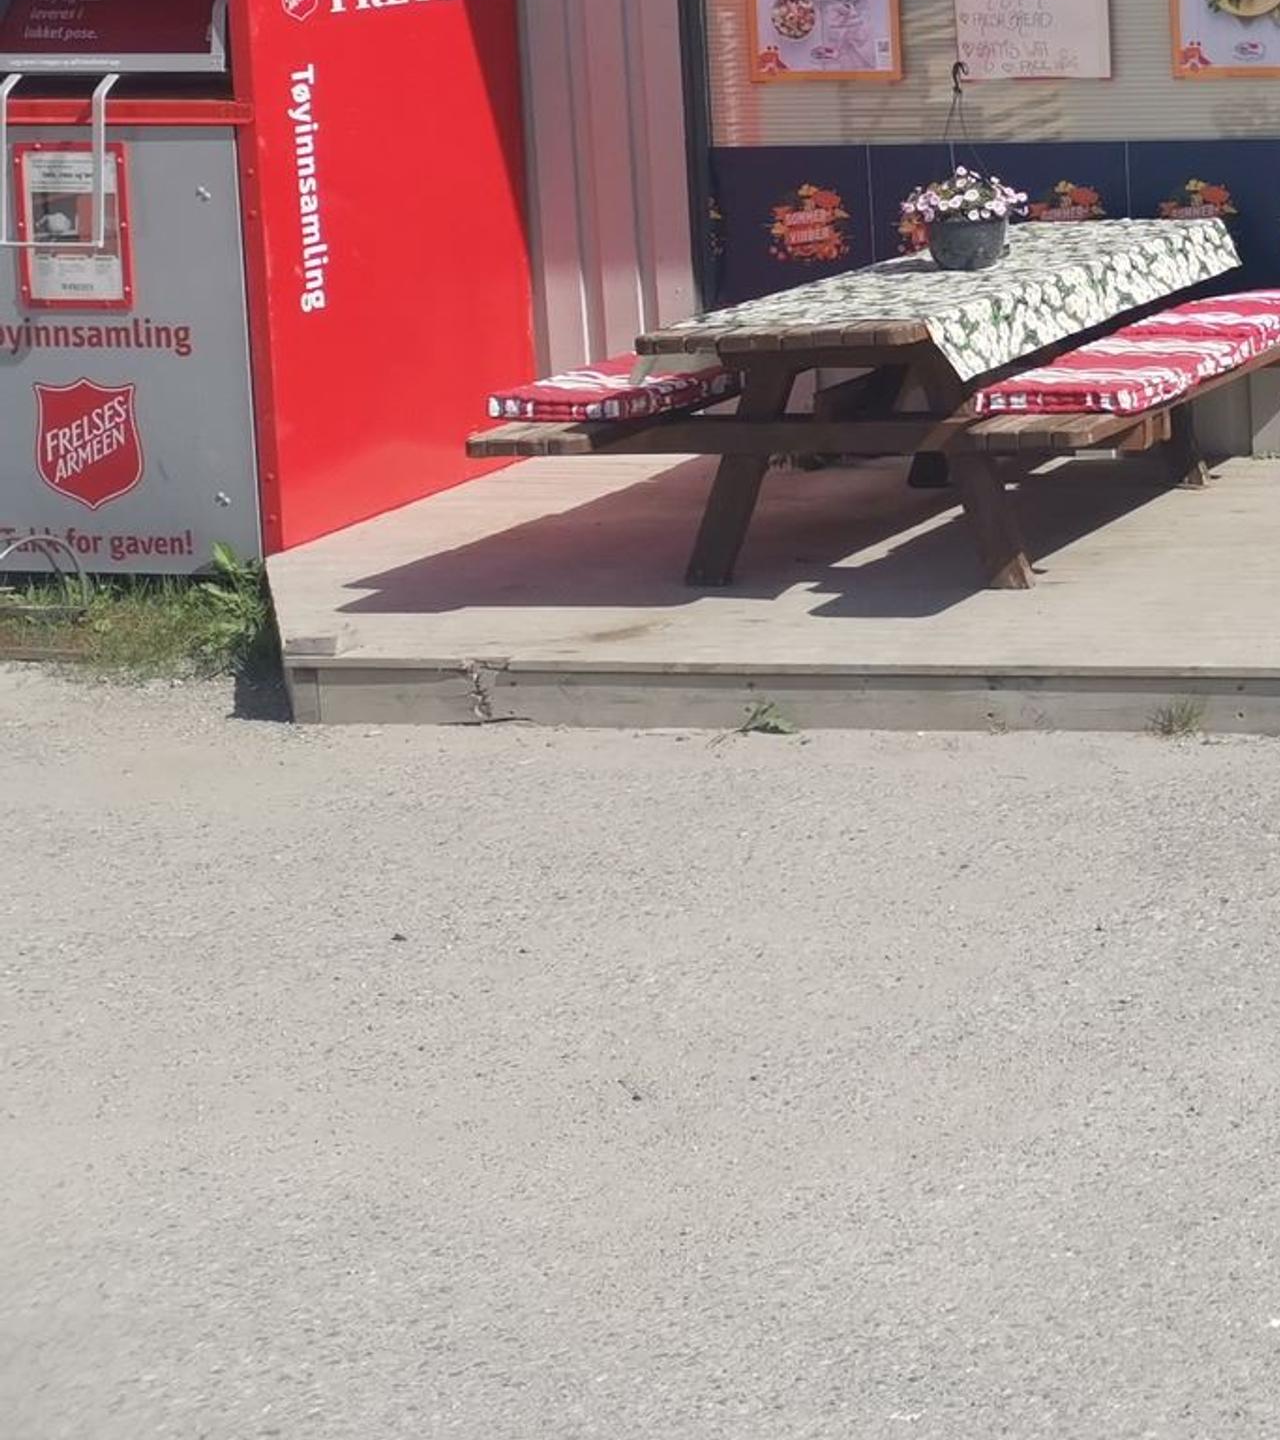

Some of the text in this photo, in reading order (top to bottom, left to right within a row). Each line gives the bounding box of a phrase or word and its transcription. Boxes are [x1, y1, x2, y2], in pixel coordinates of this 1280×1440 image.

[288, 63, 329, 314] Tøyinnsamling
[54, 424, 125, 484] ARMEEN
[65, 528, 102, 554] for
[110, 529, 193, 560] gaven!
